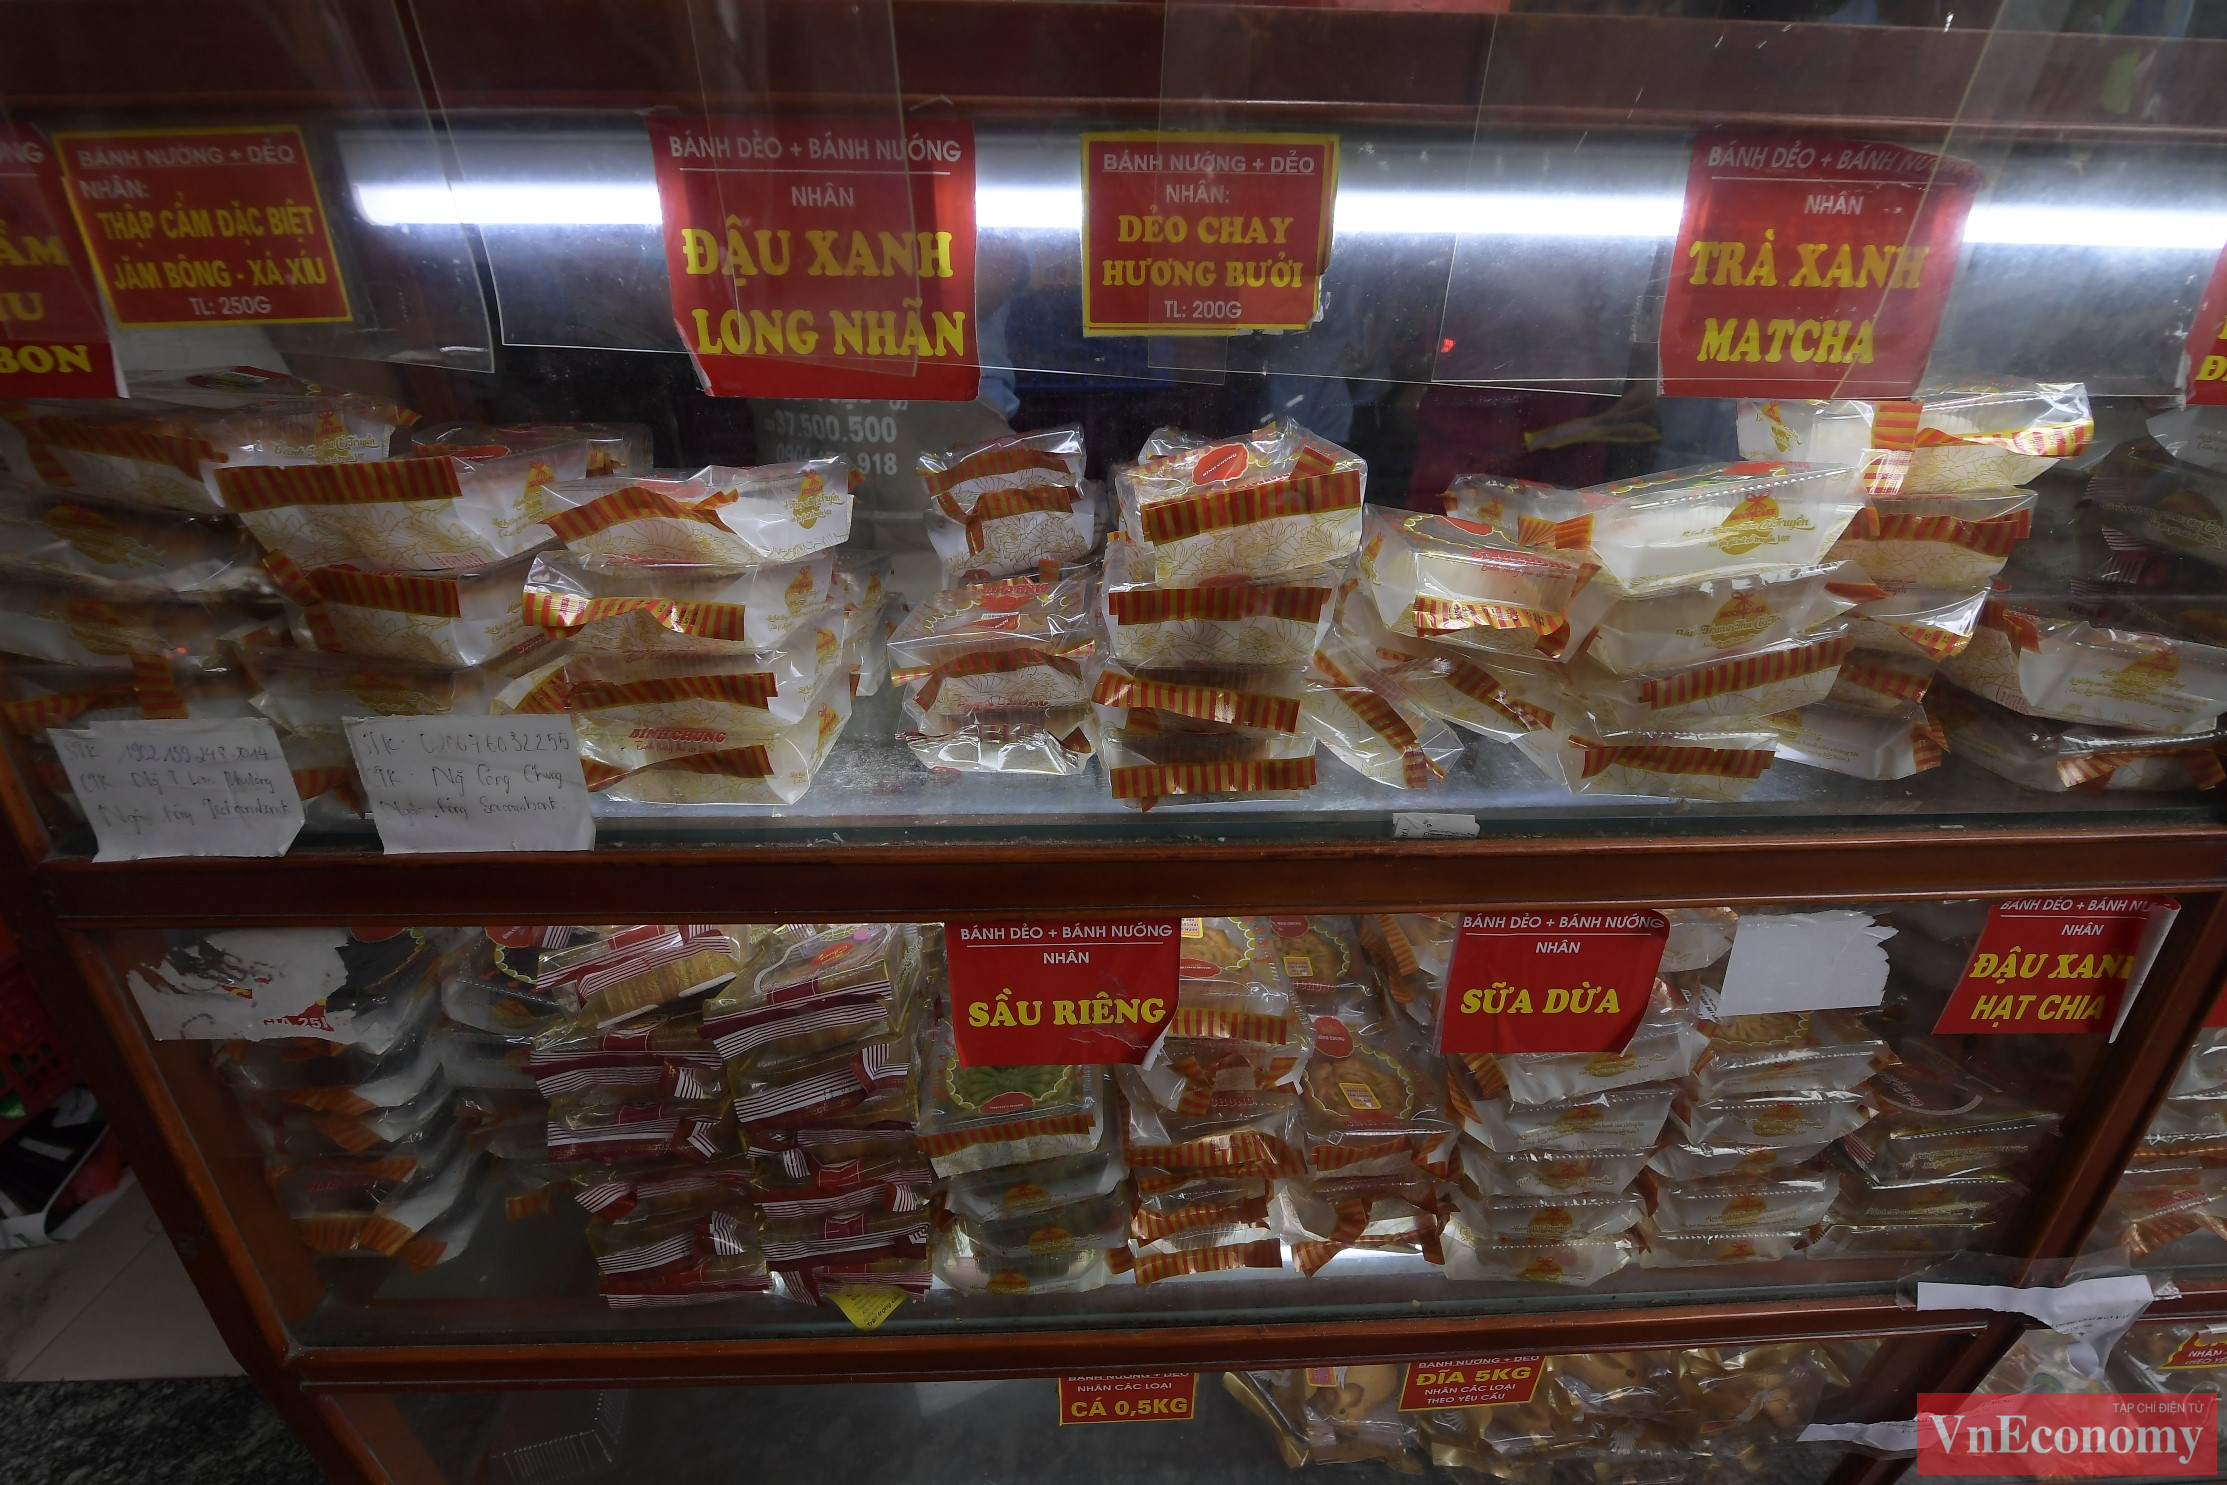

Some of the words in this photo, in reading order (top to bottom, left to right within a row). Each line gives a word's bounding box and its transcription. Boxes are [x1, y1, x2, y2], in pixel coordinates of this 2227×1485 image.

[670, 130, 730, 158] BÁNH
[738, 128, 782, 159] DẺO
[790, 144, 801, 157] +
[809, 132, 869, 160] BÁNH
[1708, 143, 1764, 168] BÁNH
[1771, 140, 1816, 168] DẺO
[1837, 145, 1894, 171] BÁNH
[77, 145, 137, 167] BÁNH
[1103, 150, 1163, 171] BÁNH
[1270, 150, 1314, 173] DẺO
[791, 182, 854, 207] NHÂN
[1804, 191, 1863, 215] NHÂN
[97, 203, 156, 248] THẬP
[1118, 204, 1188, 243] DẺO
[1197, 216, 1294, 244] CHAY
[681, 214, 791, 286] ĐẬU
[805, 230, 953, 278] XANH
[1102, 257, 1217, 288] HƯƠNG
[1224, 251, 1304, 287] BƯỞI
[1789, 243, 1930, 289] XANH
[221, 296, 272, 316] 250G
[1164, 300, 1187, 319] TL:
[1192, 301, 1242, 319] 200G
[692, 309, 819, 355] LONG
[829, 297, 965, 357] NHÃN
[1697, 317, 1874, 364] MATCHA
[2087, 896, 2128, 912] BÁNH
[961, 925, 1005, 940] BÁNH
[1010, 923, 1043, 940] DẺO
[1048, 929, 1057, 938] +
[1062, 923, 1106, 938] BÁNH
[1111, 922, 1172, 938] NƯỚNG
[1463, 913, 1506, 928] BÁNH
[1510, 913, 1542, 929] DẺO
[1546, 918, 1555, 928] +
[1558, 913, 1601, 928] BÁNH
[2061, 922, 2104, 936] NHÂN
[1043, 950, 1089, 964] NHÂN
[1535, 939, 1581, 954] NHÂN
[1968, 945, 2048, 984] ĐẬU
[968, 987, 1042, 1027] SẦU
[1053, 991, 1166, 1025] RIÊNG
[1460, 981, 1534, 1014] SỮA
[1542, 981, 1620, 1014] DỪA
[1970, 994, 2037, 1028] HẠT
[2037, 994, 2105, 1021] CHIA
[1145, 1382, 1172, 1390] LOẠI
[1416, 1368, 1465, 1386] ĐĨA
[1474, 1366, 1532, 1381] 5KG
[1427, 1396, 1455, 1404] THEO
[1458, 1394, 1479, 1402] YÊU
[1460, 1384, 1487, 1393] CÁC
[1489, 1383, 1516, 1391] LOẠI
[1070, 1396, 1107, 1417] CÁ
[1114, 1397, 1188, 1417] 0,5KG
